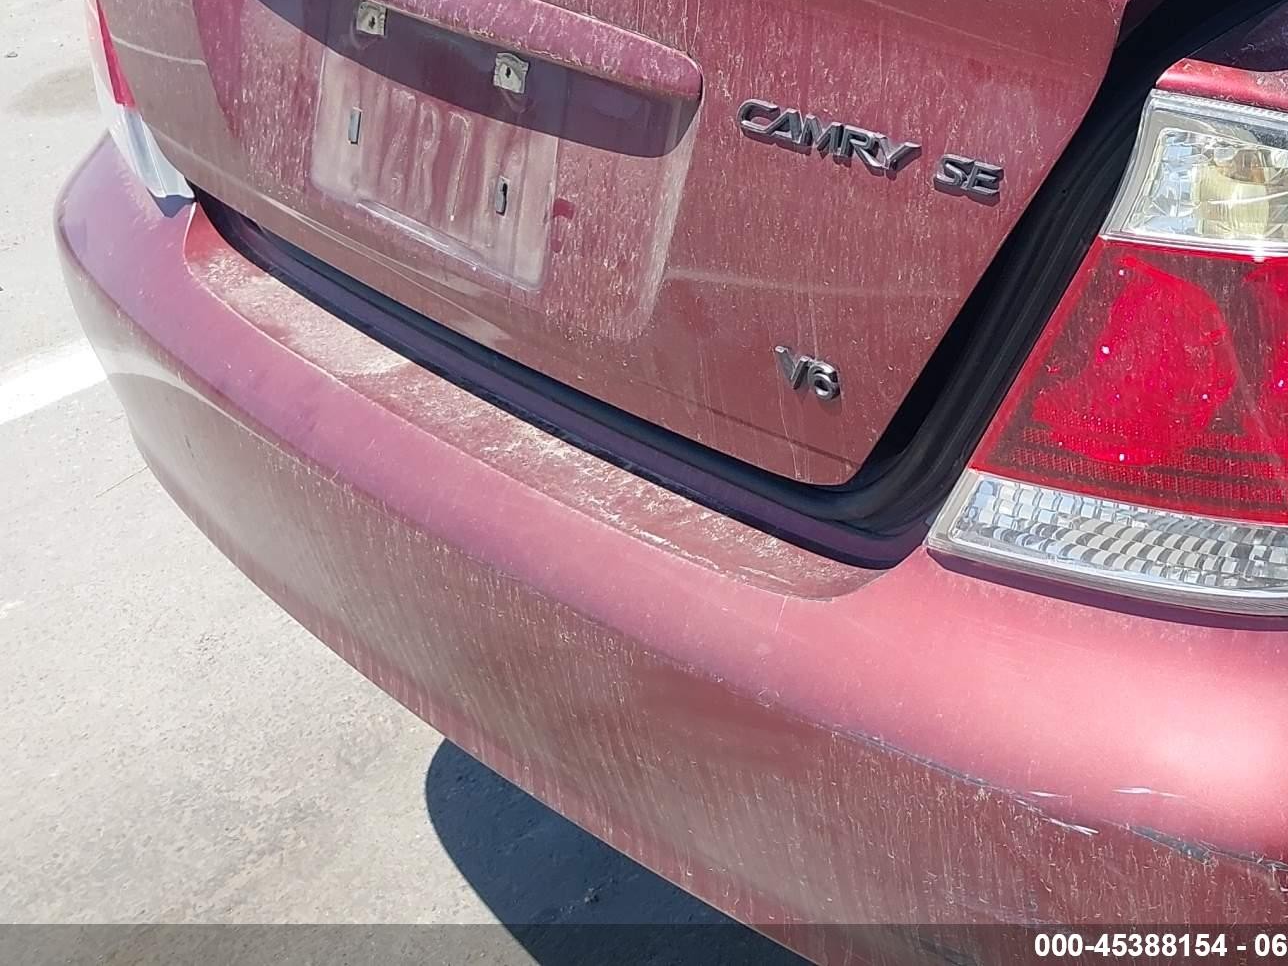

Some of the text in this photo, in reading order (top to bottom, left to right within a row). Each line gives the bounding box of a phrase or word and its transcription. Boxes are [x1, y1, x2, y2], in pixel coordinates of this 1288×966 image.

[737, 98, 1005, 203] CAMRY SE
[774, 344, 841, 401] V6
